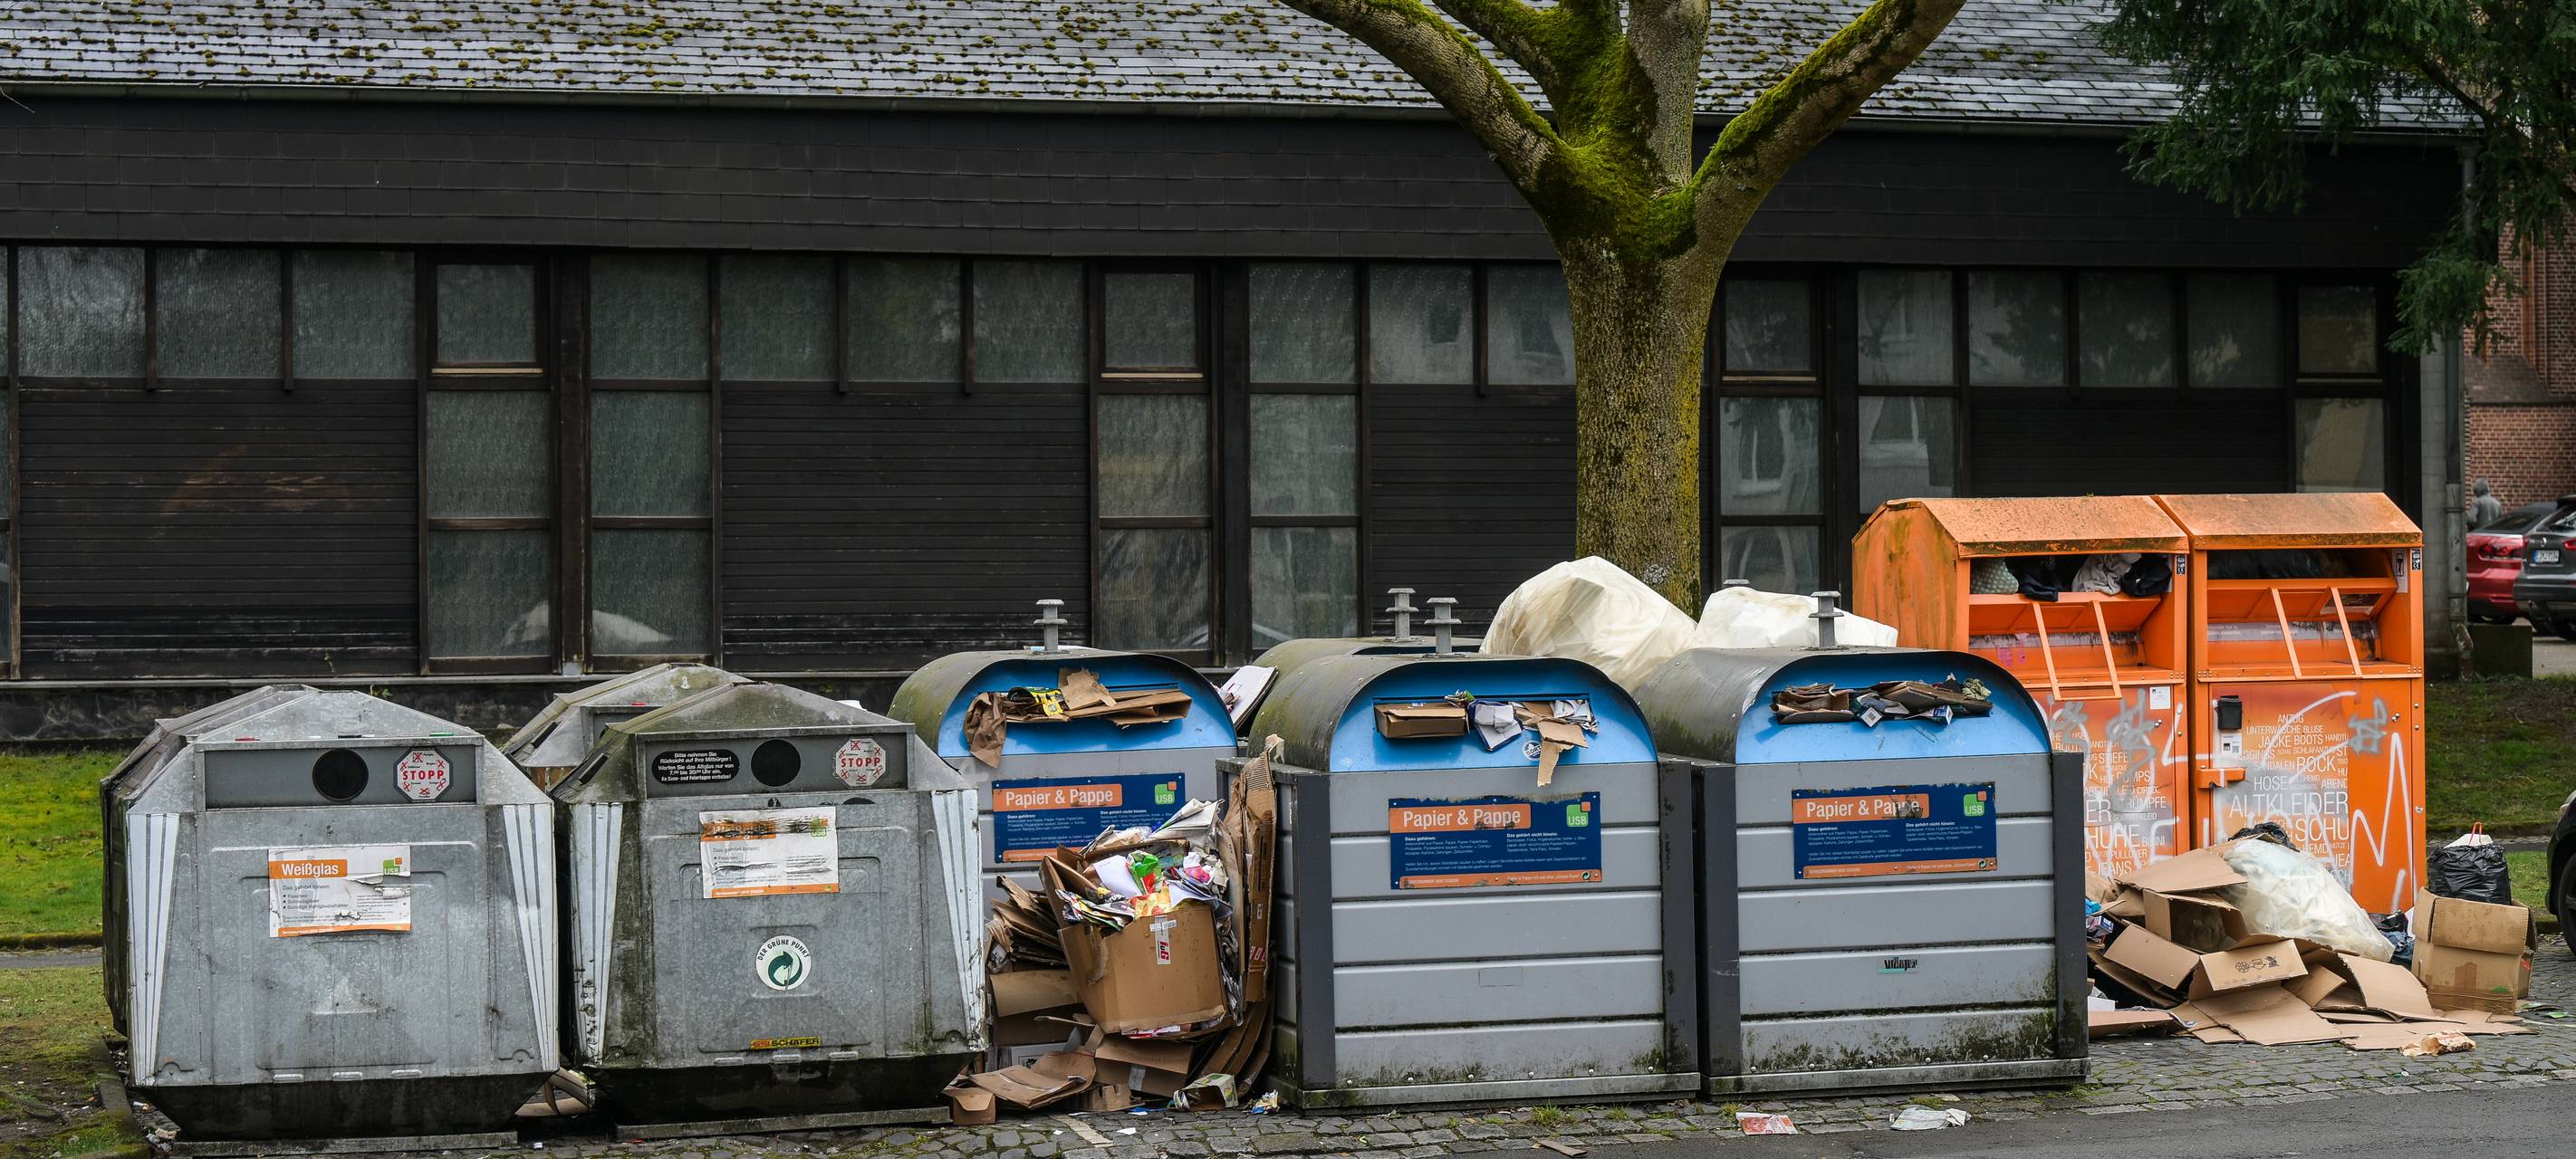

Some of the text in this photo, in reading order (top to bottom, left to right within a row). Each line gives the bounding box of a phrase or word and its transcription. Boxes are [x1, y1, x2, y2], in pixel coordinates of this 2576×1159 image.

[2277, 714, 2304, 723] ANZUG
[2303, 724, 2324, 733] BLUSE
[2258, 735, 2292, 748] JACKE
[2293, 734, 2323, 744] BOOTS
[841, 757, 880, 767] STOPP
[2254, 761, 2295, 771] SADALEN
[2297, 755, 2337, 773] ROCK
[403, 770, 444, 781] STOPP
[2254, 776, 2287, 791] HOSE
[1005, 788, 1113, 808] Papier & Pappe
[1156, 793, 1174, 803] USB
[2230, 791, 2349, 818] ALTKLEIDER
[1806, 800, 1919, 819] Papier & Pape
[1965, 805, 1984, 815] USB
[1403, 809, 1521, 829] Papier & Pappe
[1568, 816, 1587, 826] USB
[2295, 819, 2350, 842] SCHU
[2111, 849, 2148, 859] PULLOER
[281, 863, 339, 877] Weißglas
[758, 948, 768, 961] DER
[767, 939, 789, 950] GRÜNE
